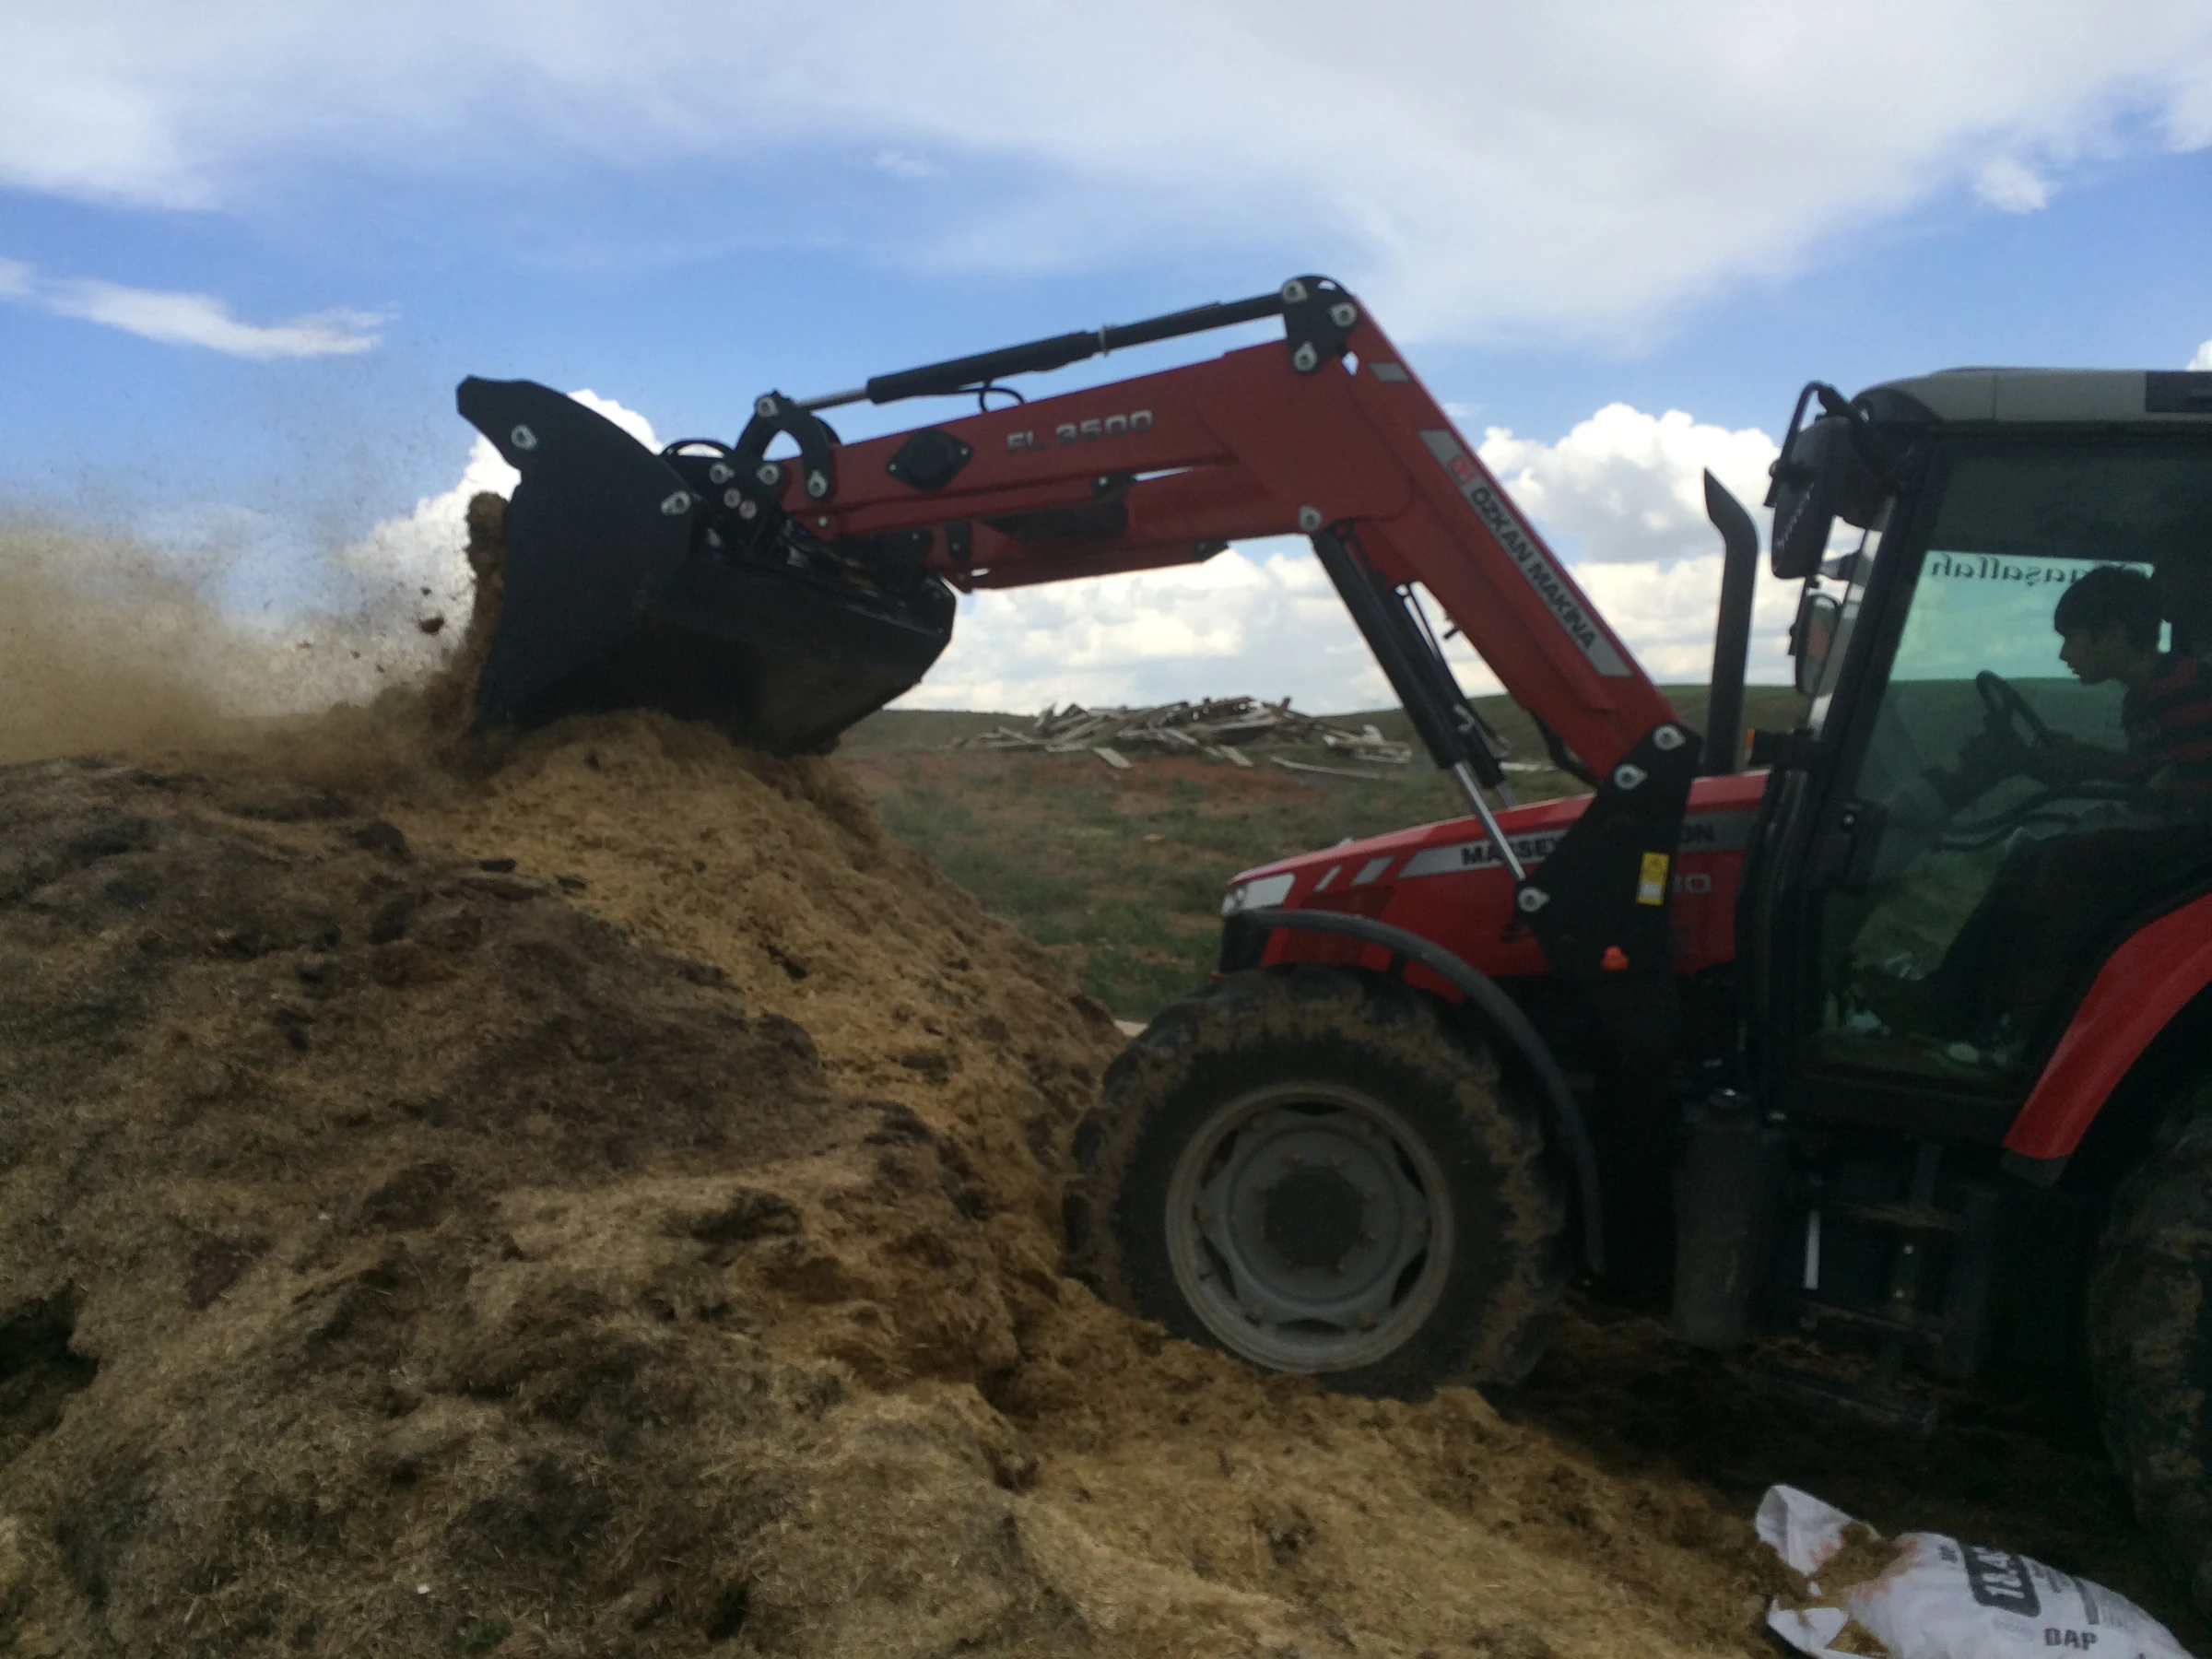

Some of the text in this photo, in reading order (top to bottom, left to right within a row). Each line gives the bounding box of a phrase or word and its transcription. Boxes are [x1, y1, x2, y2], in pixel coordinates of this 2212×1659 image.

[1006, 410, 1153, 453] FL 3500
[2044, 1628, 2098, 1651] DAP
